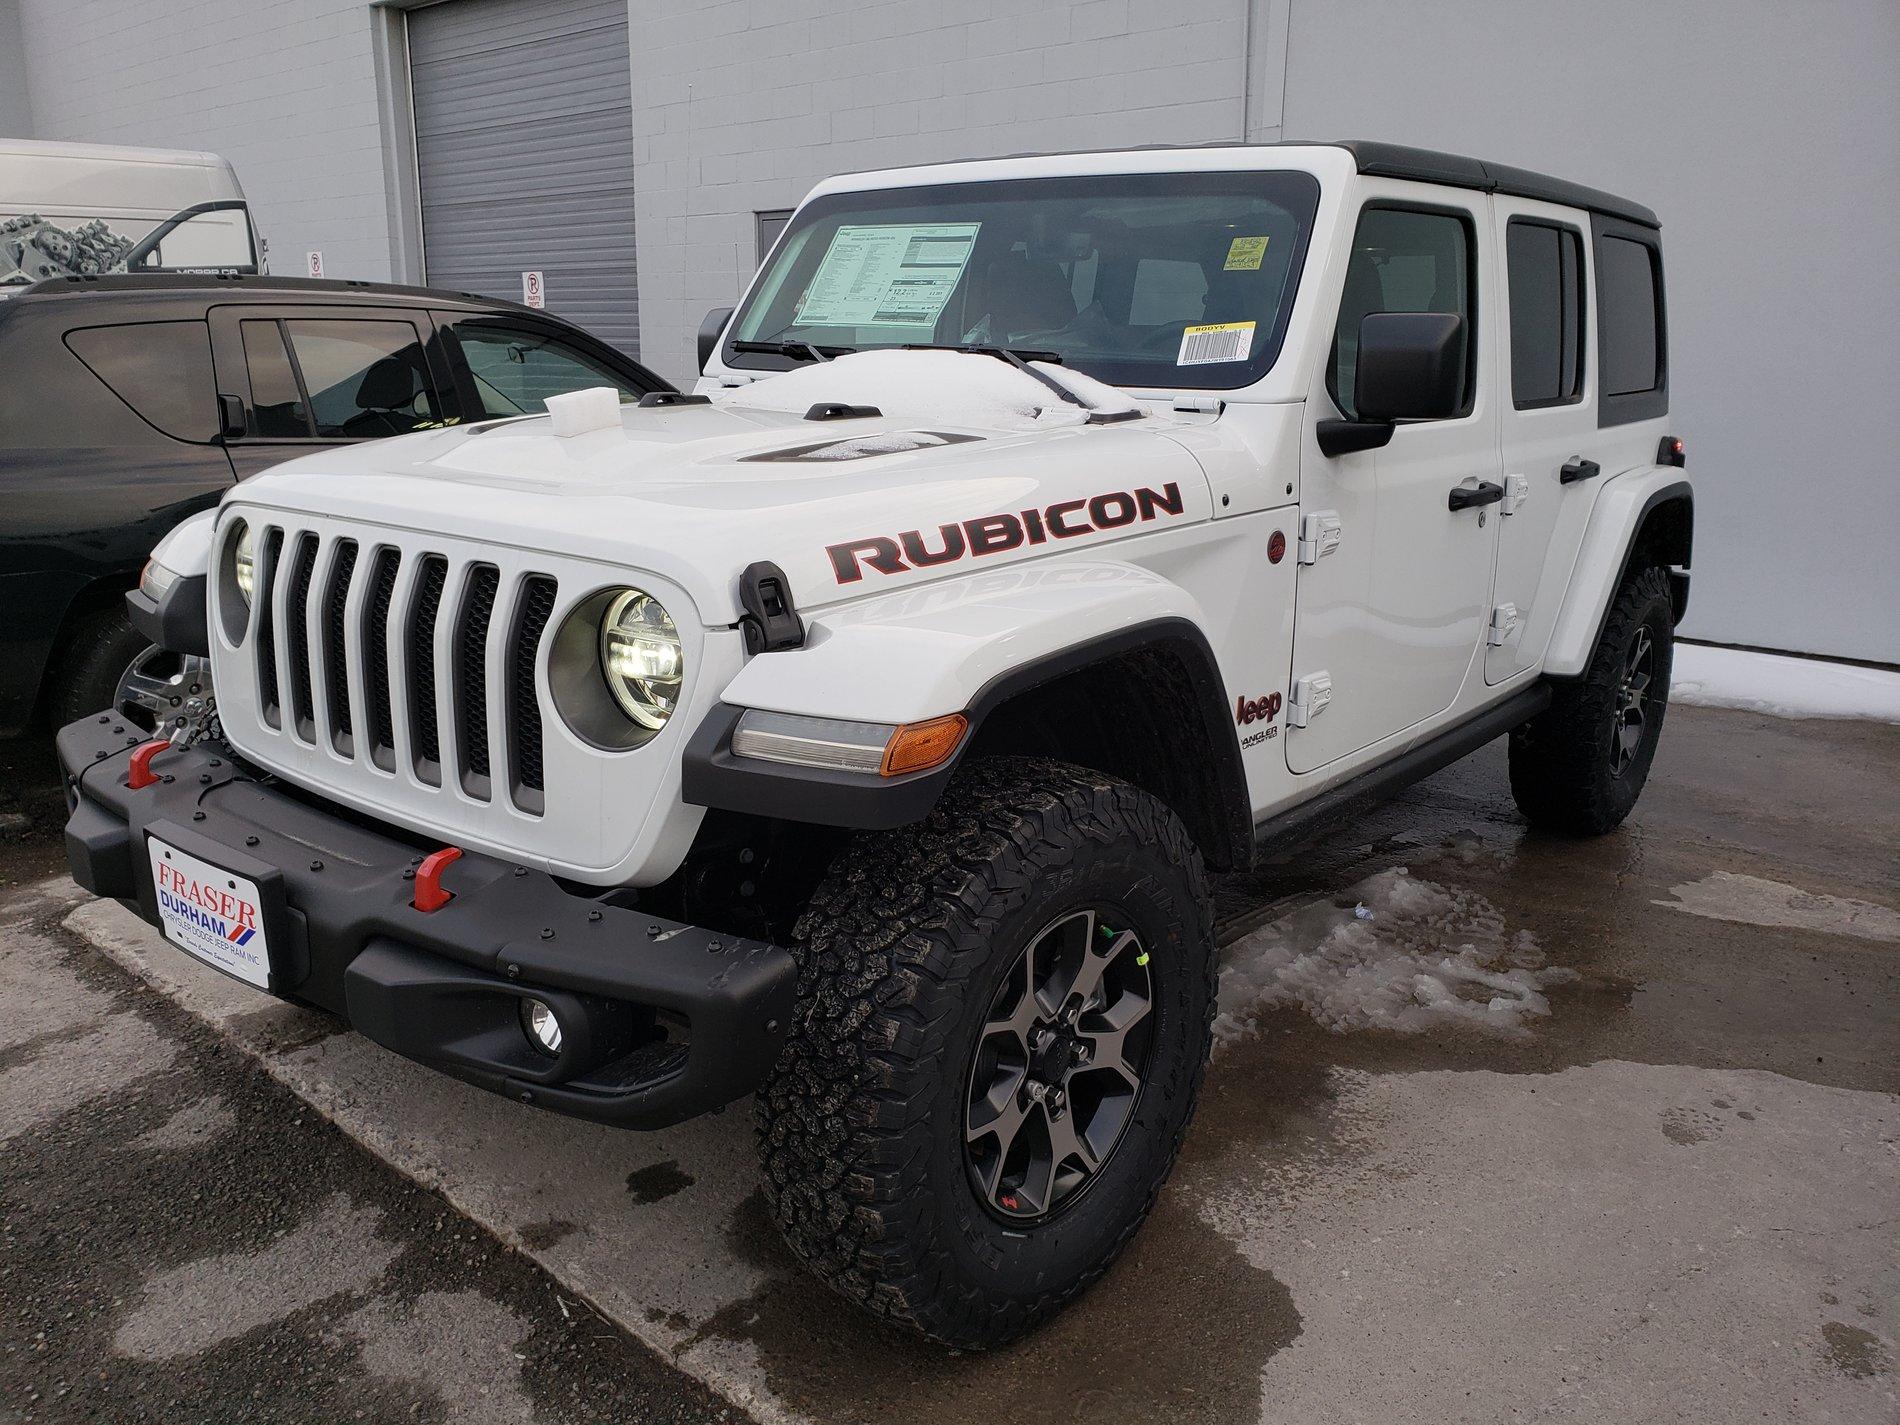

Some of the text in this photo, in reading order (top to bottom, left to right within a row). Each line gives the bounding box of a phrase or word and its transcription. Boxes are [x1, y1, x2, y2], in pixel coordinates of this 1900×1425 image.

[825, 482, 1184, 585] RUBICON
[1236, 691, 1282, 727] Jeep
[1240, 725, 1278, 746] ANGLER
[158, 860, 256, 929] FRASER
[160, 889, 227, 938] DURHAM
[163, 909, 260, 966] CHRYSLER DODGE JEEP RAM INC
